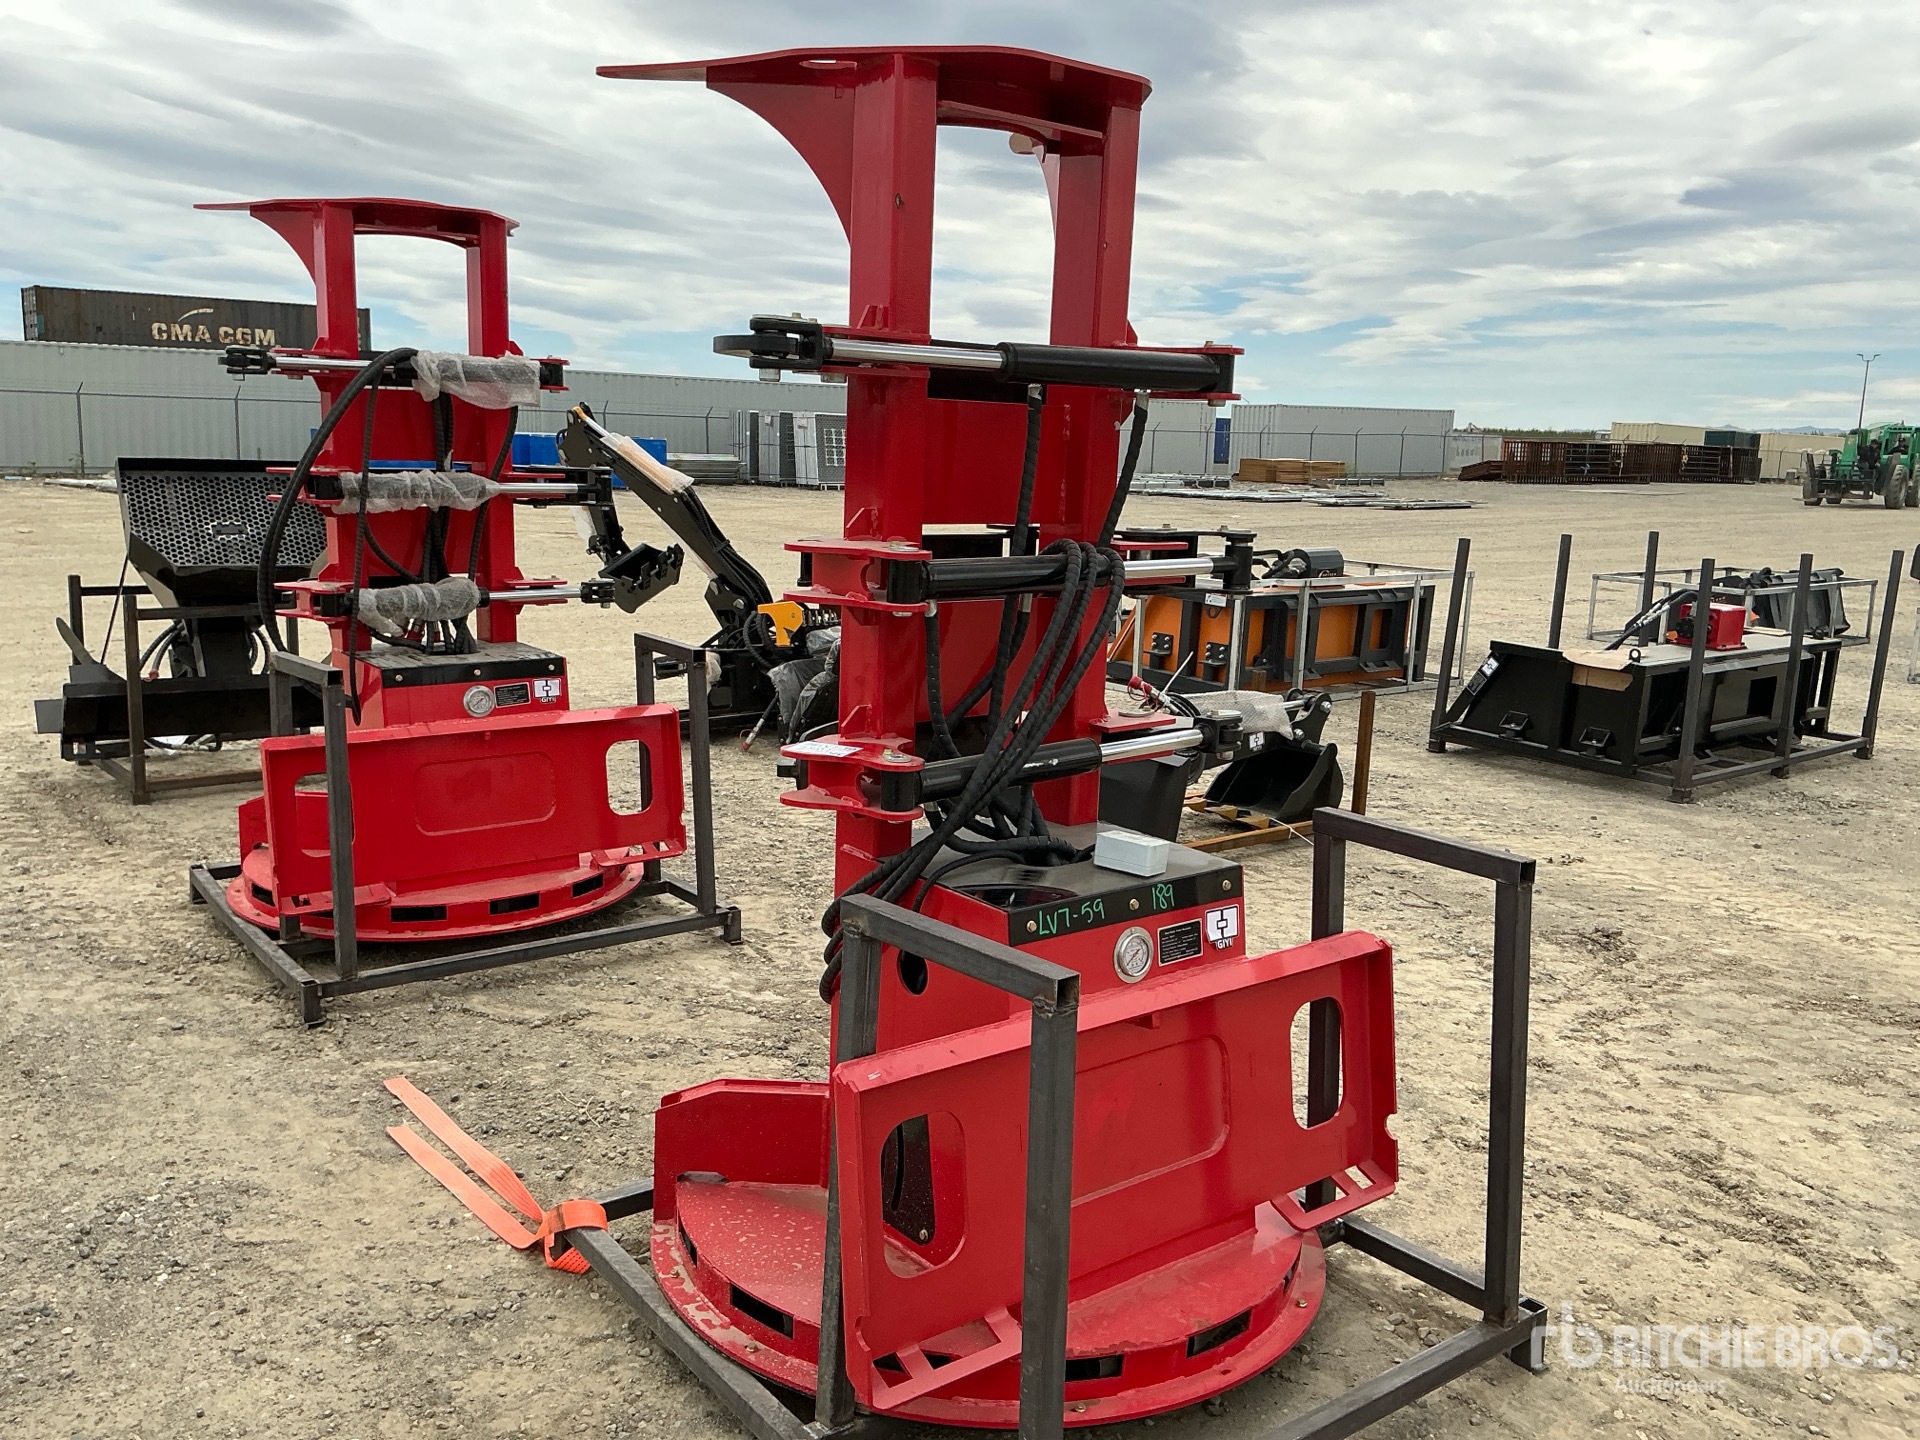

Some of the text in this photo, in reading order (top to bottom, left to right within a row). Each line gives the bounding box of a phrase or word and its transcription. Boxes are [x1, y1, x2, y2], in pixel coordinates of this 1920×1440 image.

[151, 322, 276, 346] CMA CGM
[1039, 883, 1175, 934] LV7-59 189
